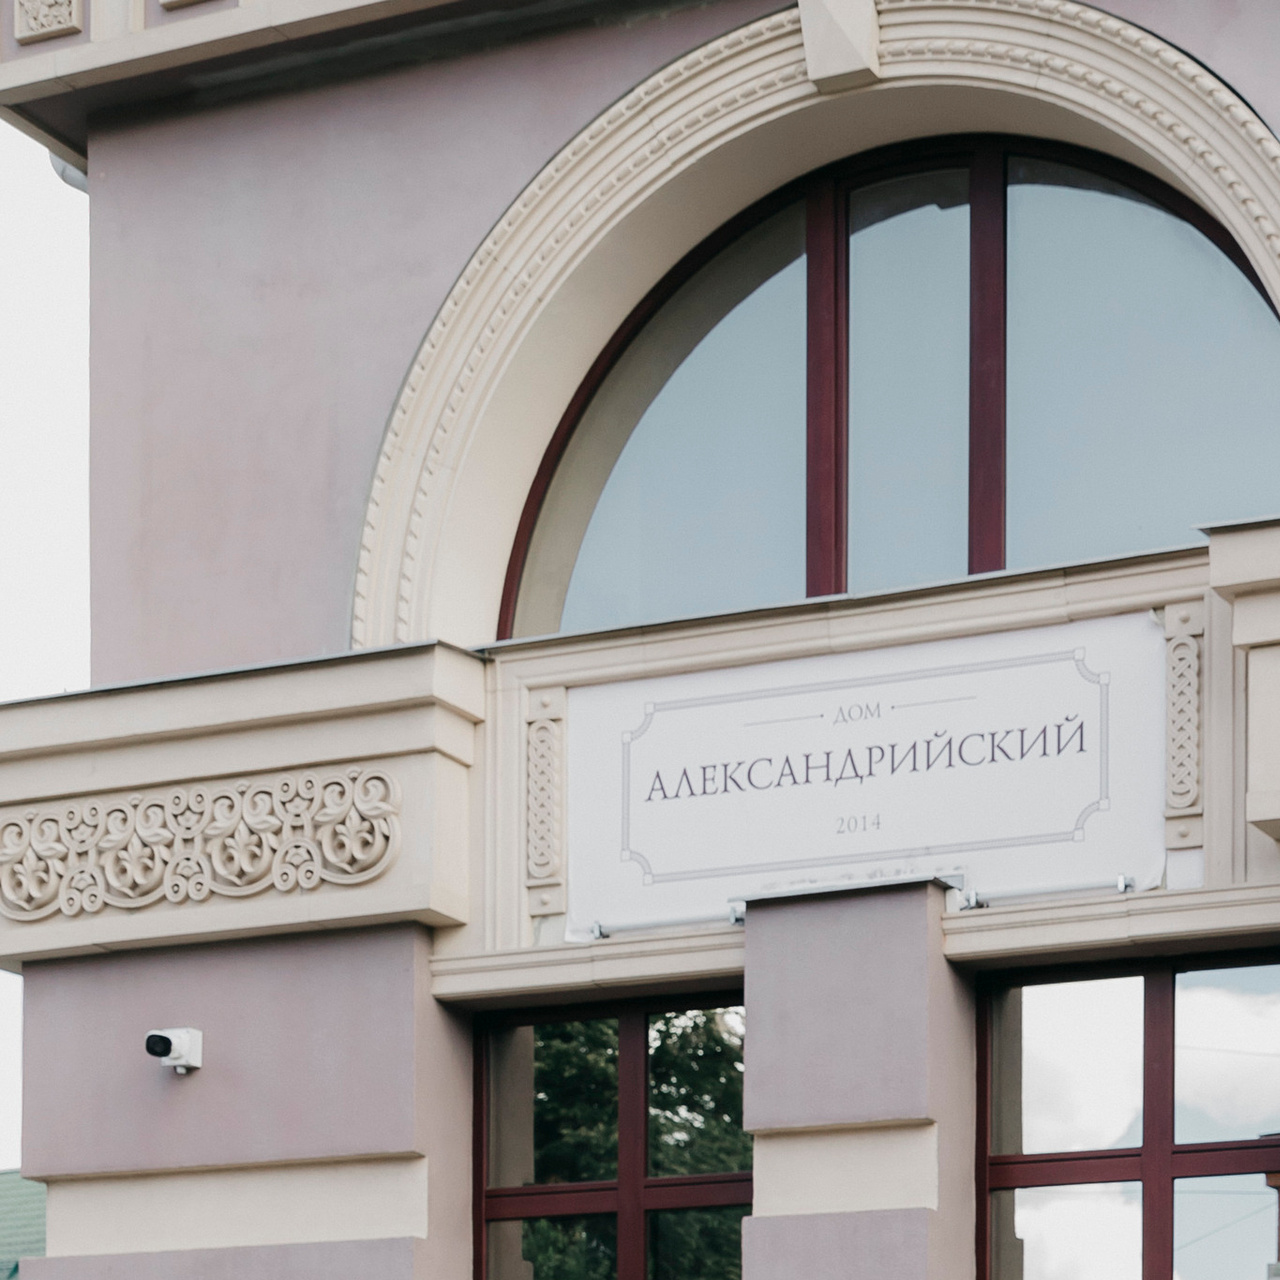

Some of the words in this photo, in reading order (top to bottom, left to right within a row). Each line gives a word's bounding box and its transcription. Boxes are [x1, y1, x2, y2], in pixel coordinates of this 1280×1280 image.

[833, 702, 882, 725] ДОМ
[645, 714, 1088, 802] АЛЕКСАНДРИЙСКИЙ
[836, 813, 882, 835] 2014
